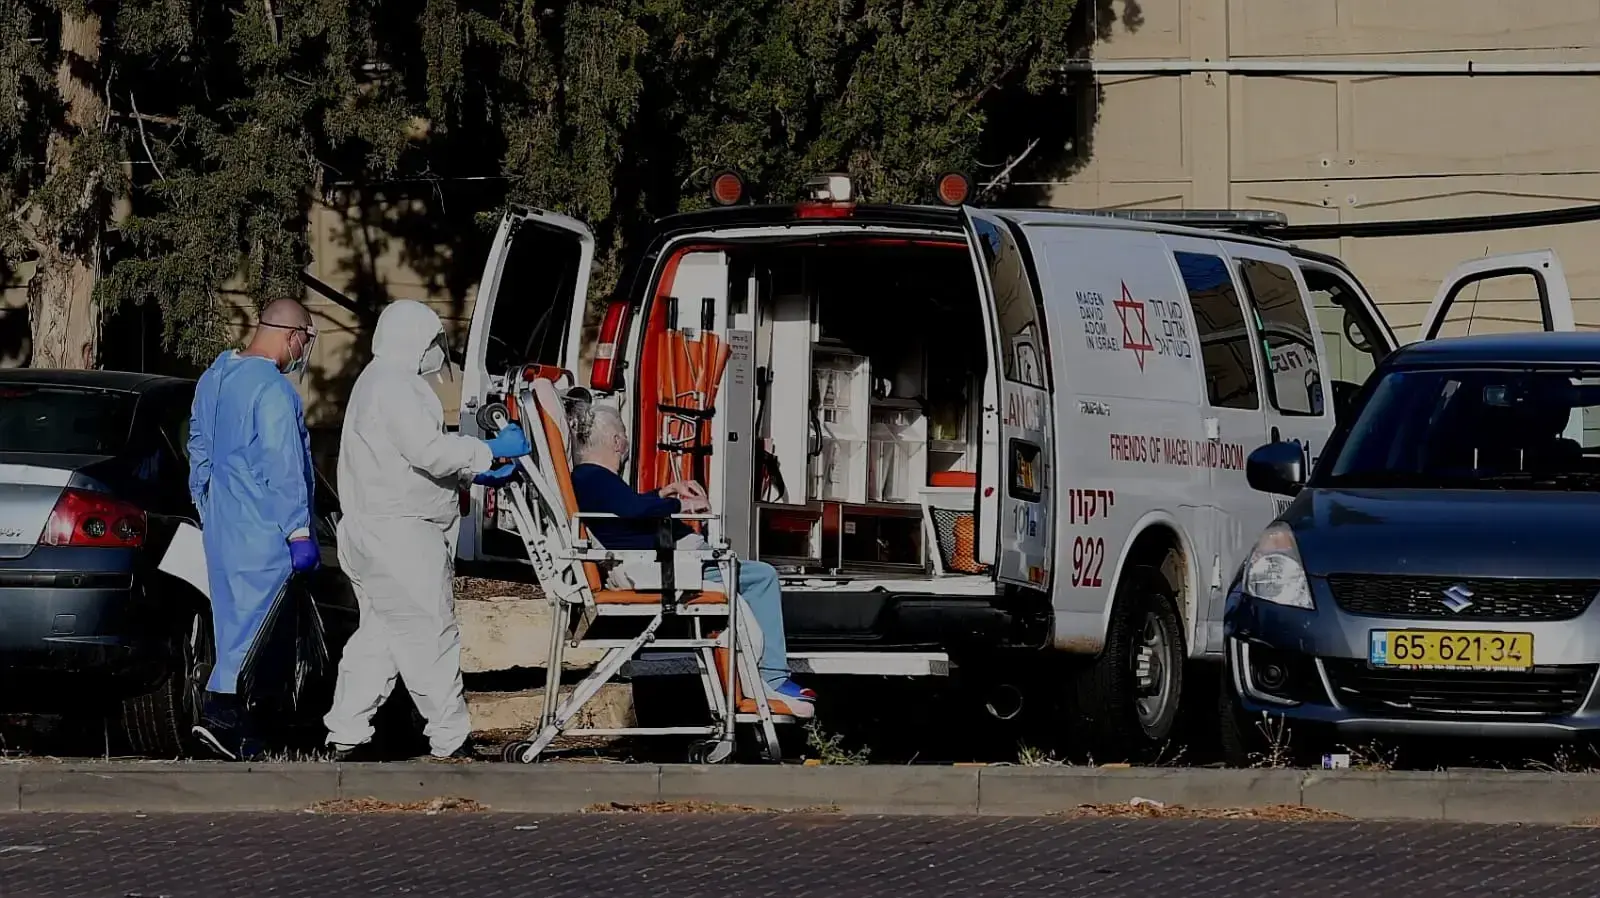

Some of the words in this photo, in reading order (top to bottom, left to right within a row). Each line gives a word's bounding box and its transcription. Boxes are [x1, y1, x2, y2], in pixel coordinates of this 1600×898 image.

[1076, 291, 1104, 306] MAGEN
[1080, 306, 1103, 320] DAVID
[1085, 321, 1107, 336] ADOM
[1086, 336, 1095, 350] IN
[1095, 337, 1120, 352] ISRAEL
[1110, 434, 1147, 463] FRIENDS
[1149, 436, 1160, 463] OF
[1163, 438, 1193, 465] MAGEN
[1220, 443, 1244, 470] ADOM
[1069, 489, 1114, 525] ירקון
[1014, 504, 1030, 536] 101
[1072, 536, 1104, 587] 922
